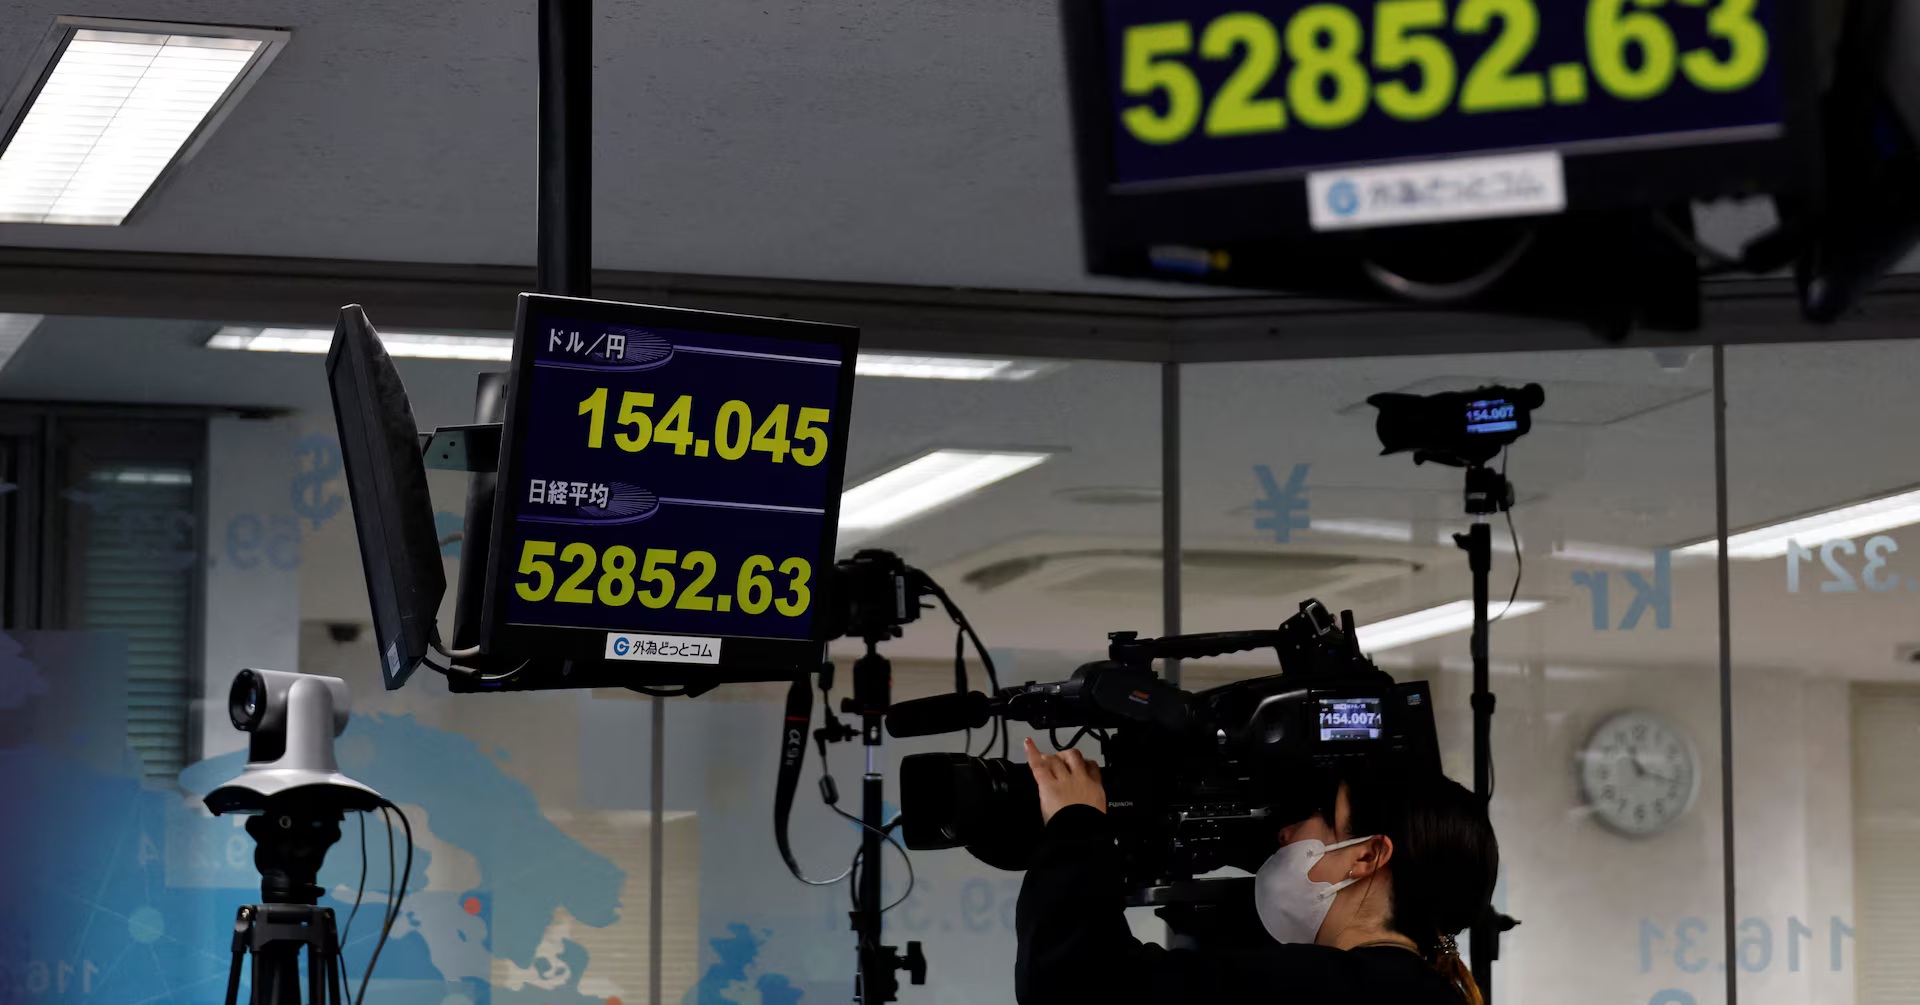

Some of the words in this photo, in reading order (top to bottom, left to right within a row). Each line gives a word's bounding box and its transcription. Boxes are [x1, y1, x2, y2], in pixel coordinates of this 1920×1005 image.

[1121, 0, 1769, 145] 52852.63
[578, 387, 831, 467] 154.045
[528, 479, 609, 508] 日経平均
[515, 540, 812, 617] 52852.63
[633, 640, 712, 657] 外為どっとコム
